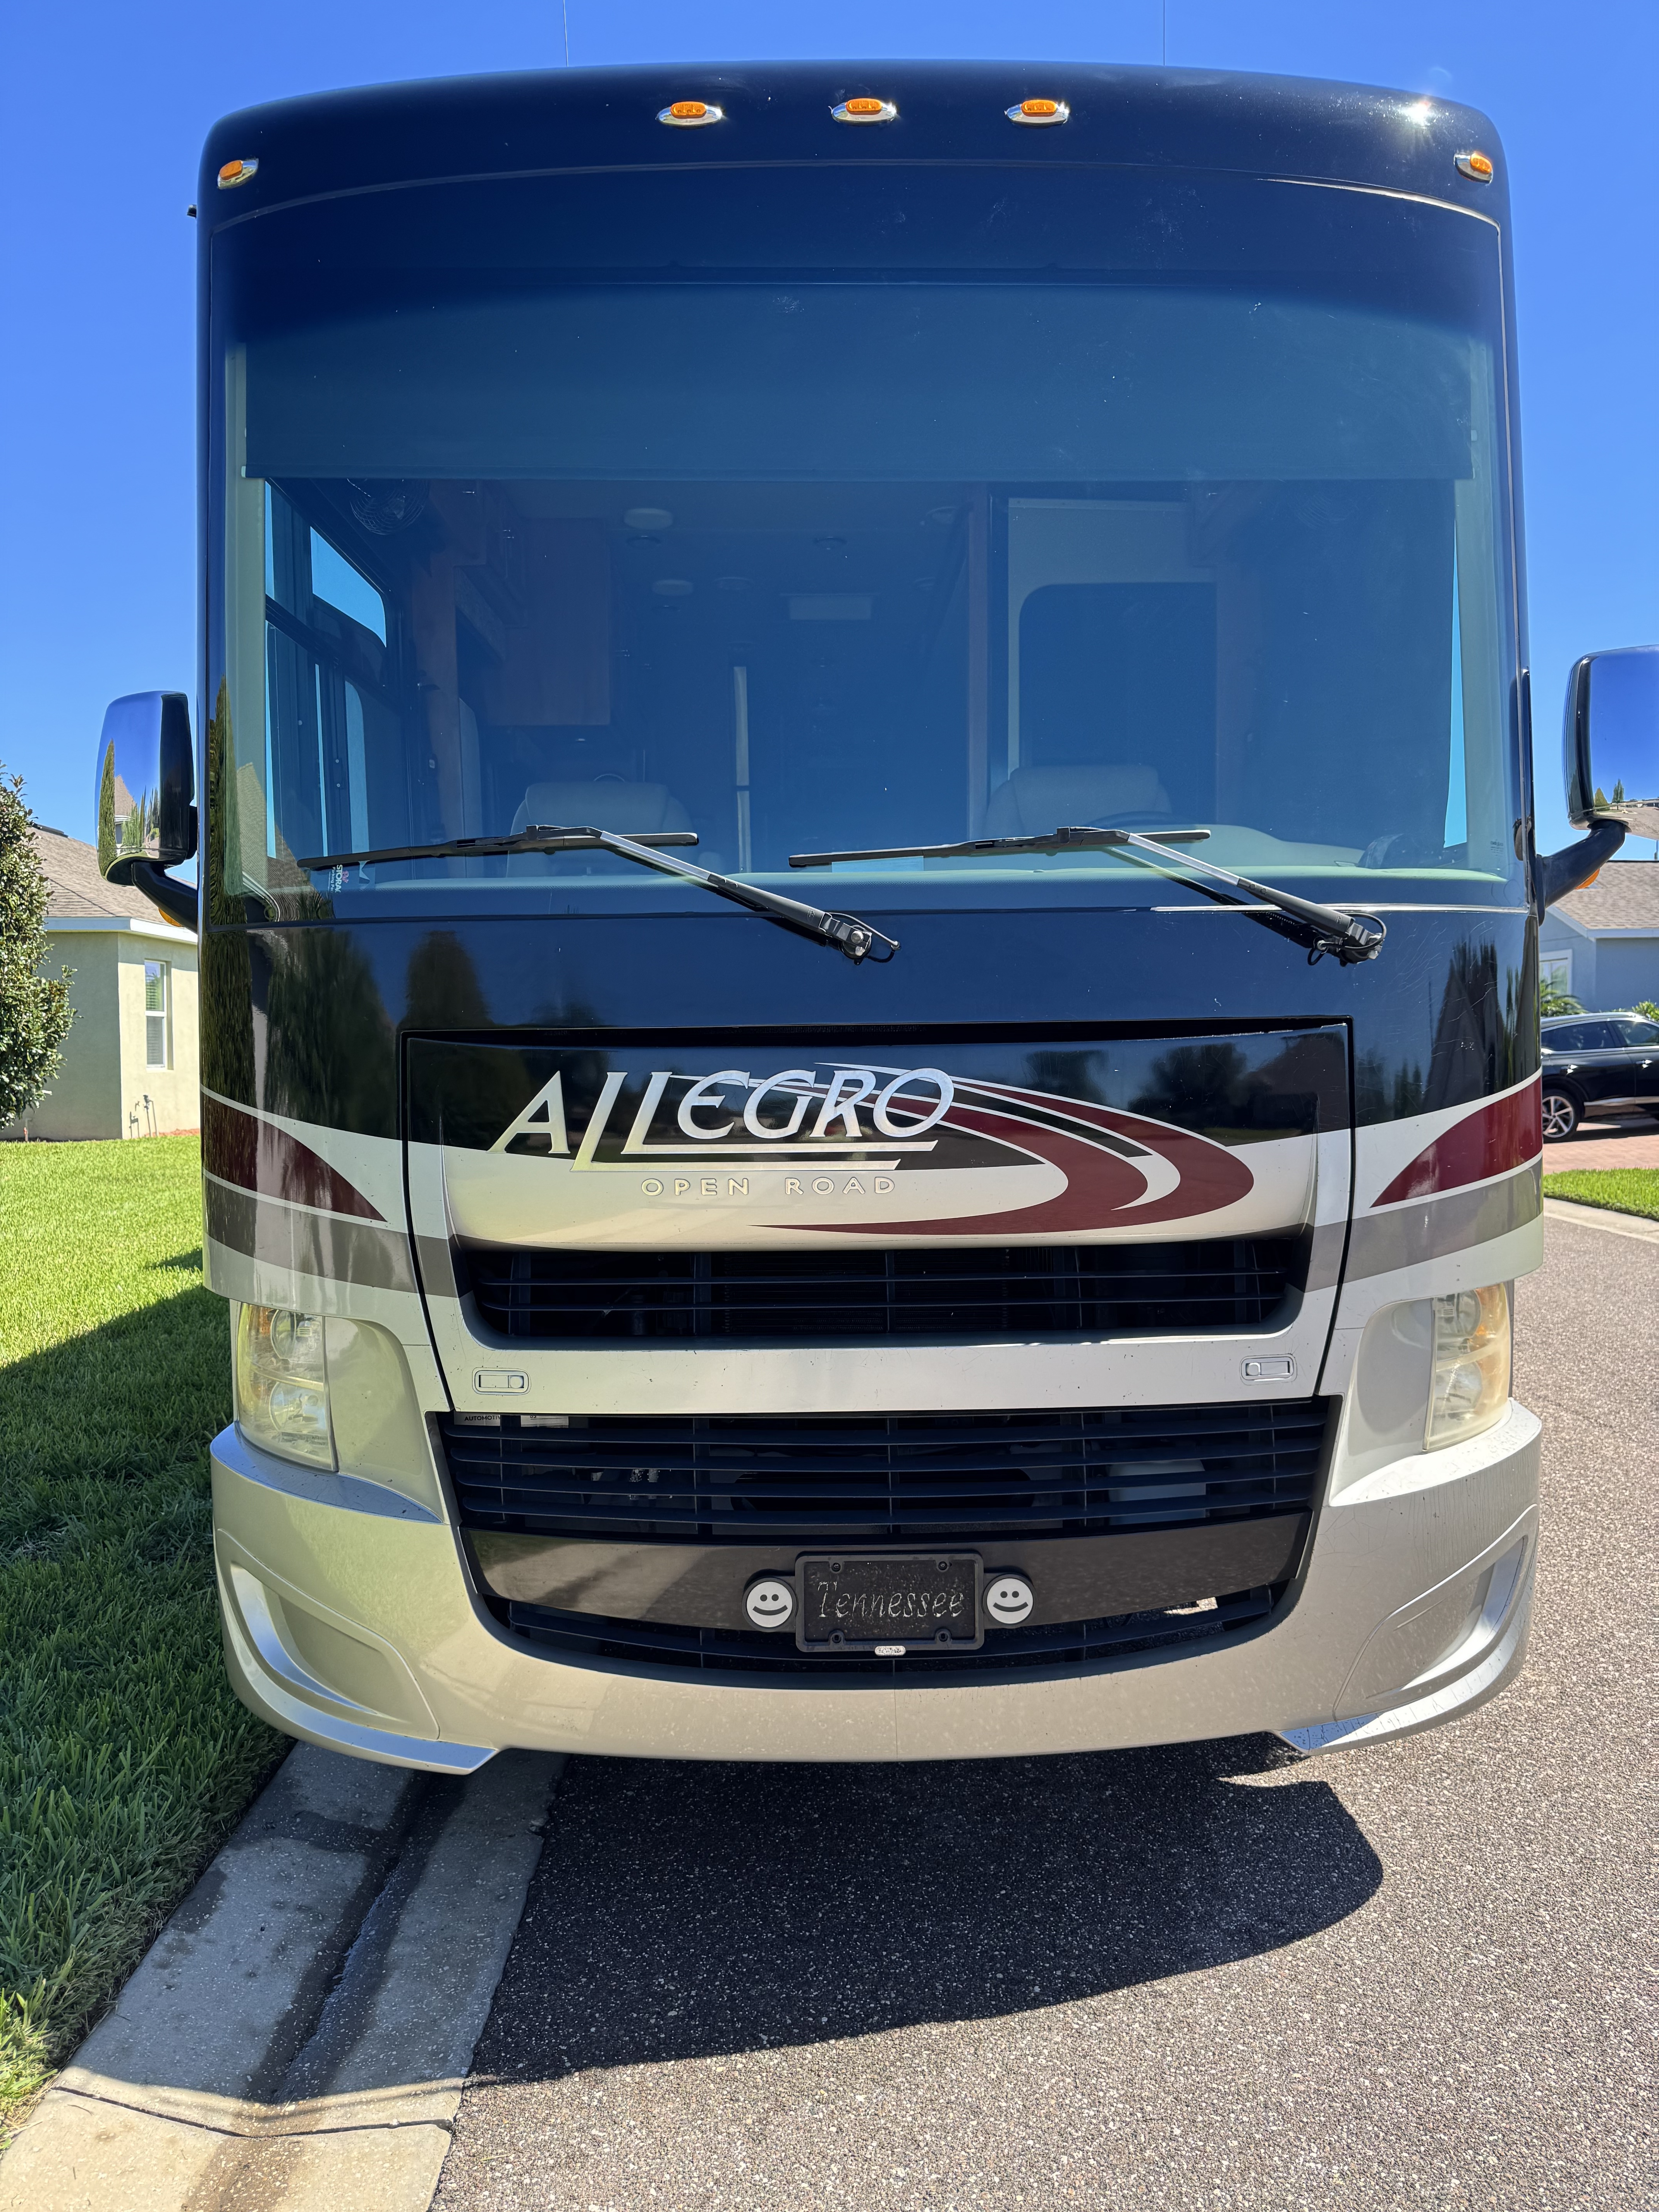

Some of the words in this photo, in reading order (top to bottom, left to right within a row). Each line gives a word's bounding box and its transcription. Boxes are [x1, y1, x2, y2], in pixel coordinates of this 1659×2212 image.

[486, 1068, 955, 1172] ALLEGRO
[641, 1178, 749, 1197] OPEN
[785, 1176, 895, 1195] ROAD
[817, 1581, 964, 1618] Tennessee
